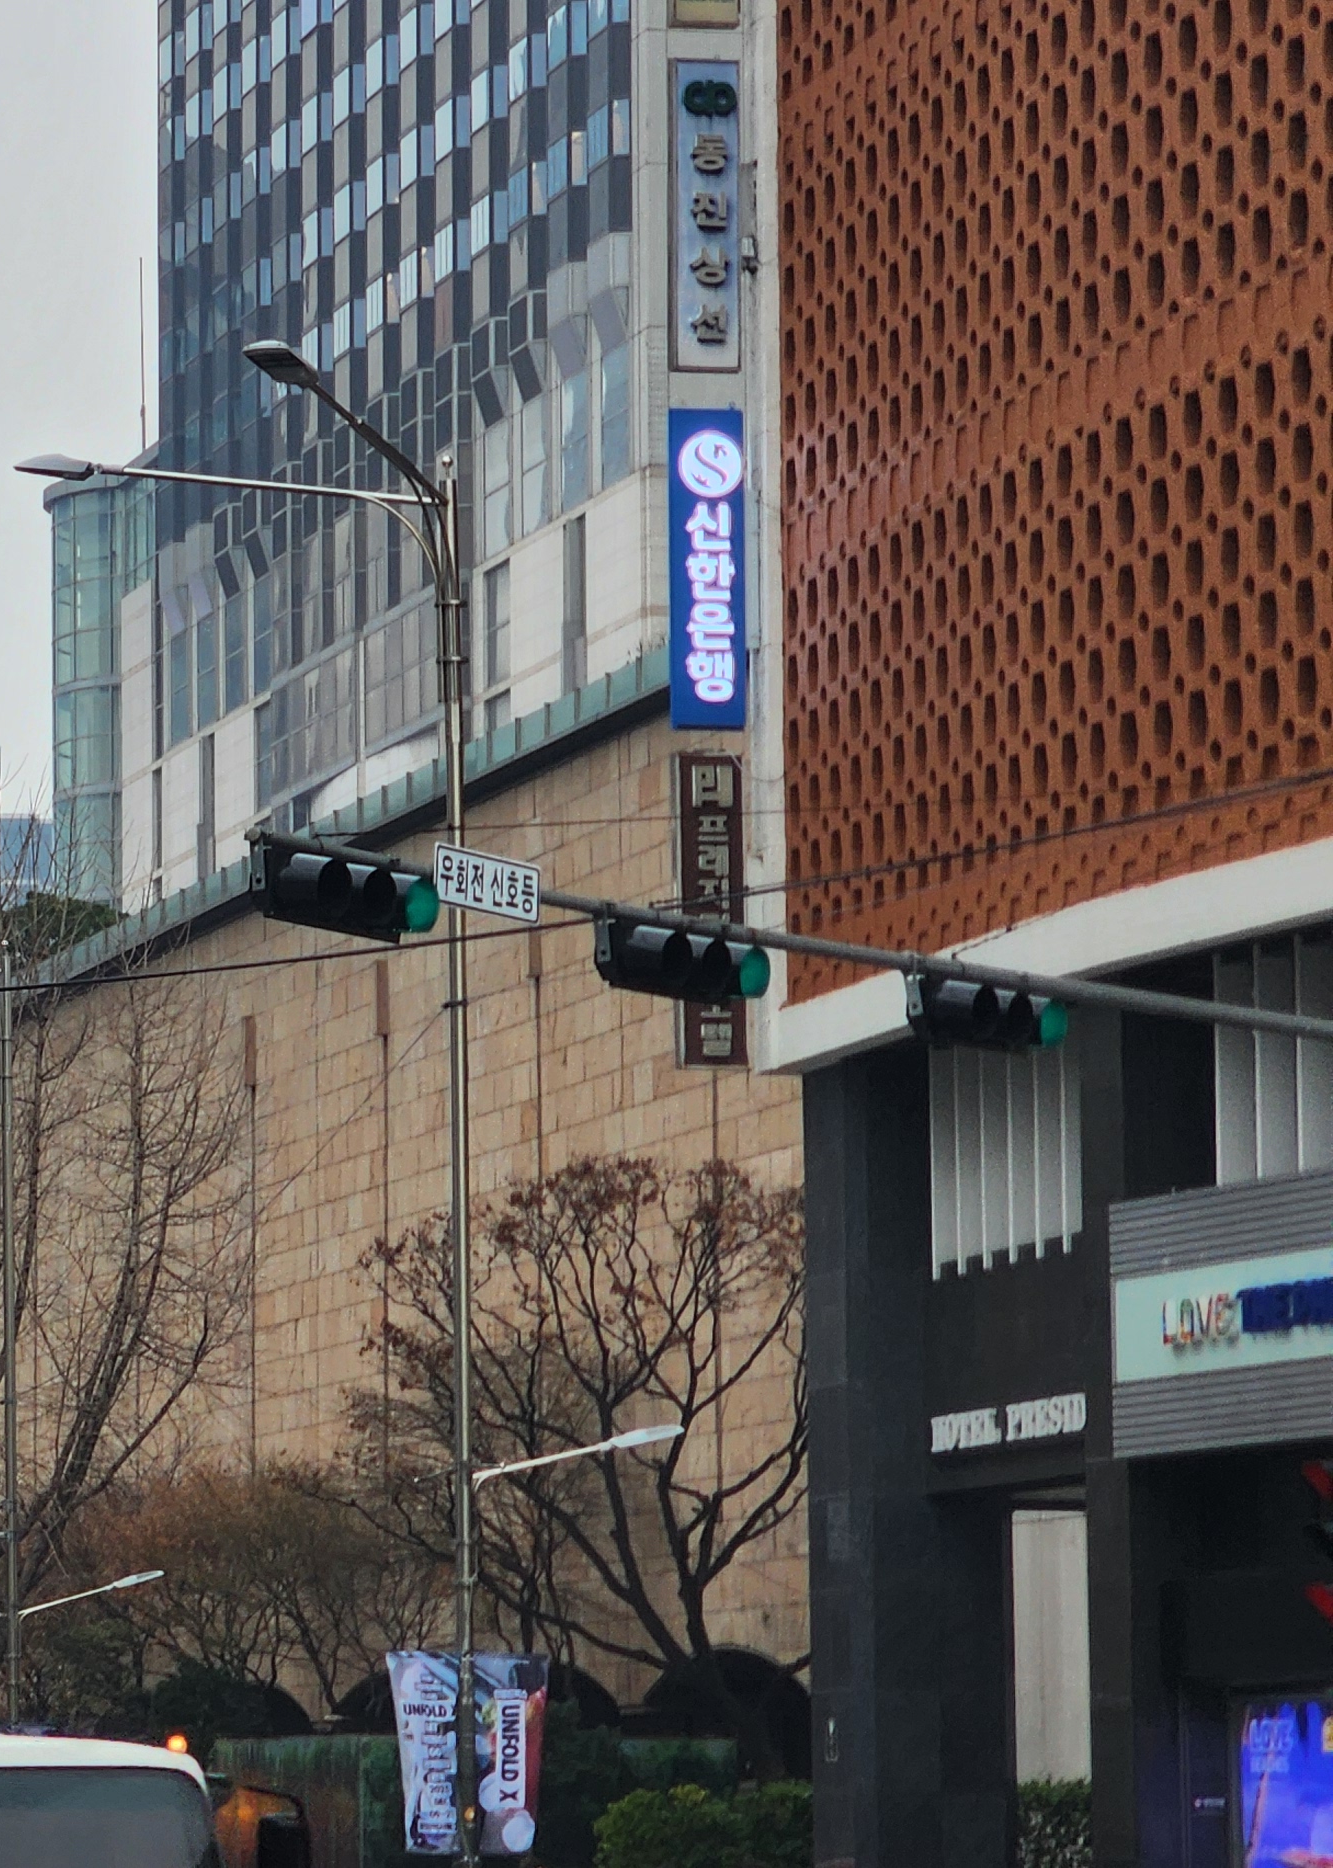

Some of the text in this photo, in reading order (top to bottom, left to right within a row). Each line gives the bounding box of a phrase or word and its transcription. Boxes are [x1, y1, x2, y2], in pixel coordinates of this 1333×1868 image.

[686, 501, 735, 703] 신한은행
[440, 855, 535, 913] 우회전 신호등
[931, 1407, 1002, 1453] HOTEL
[499, 1704, 520, 1802] UNFOLD X
